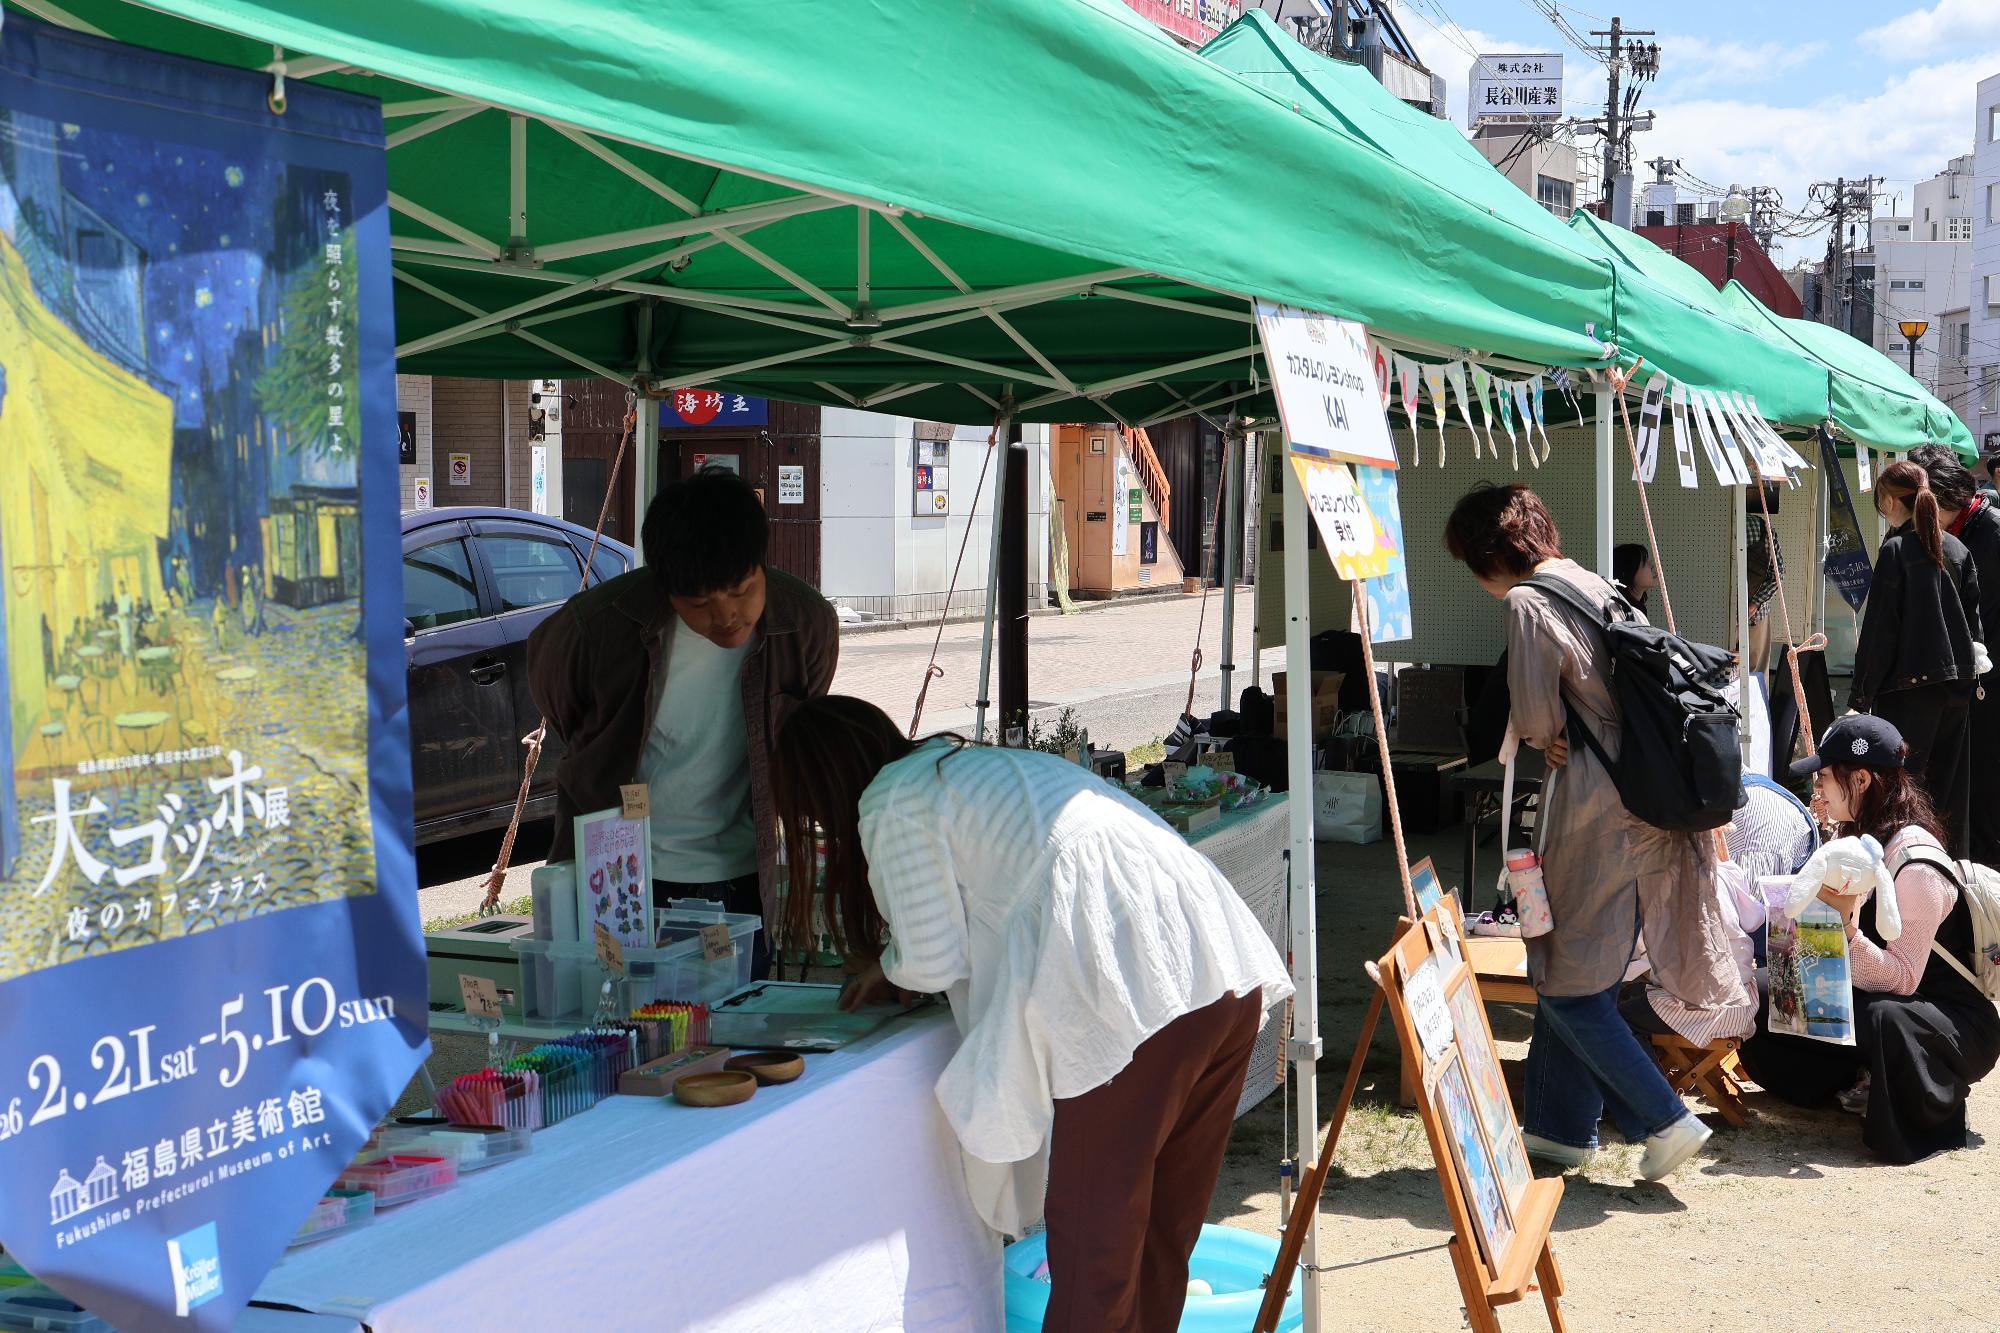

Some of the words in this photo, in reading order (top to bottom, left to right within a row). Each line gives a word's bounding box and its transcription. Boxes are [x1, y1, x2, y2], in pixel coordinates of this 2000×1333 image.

[1498, 63, 1544, 73] 株式会社
[1485, 86, 1557, 105] 長谷川産業
[678, 393, 750, 413] 海坊主
[1323, 394, 1350, 431] KAI
[1334, 520, 1355, 541] 受付
[31, 750, 291, 898] 大ゴッホ展
[66, 873, 267, 941] 夜のカフェテラス
[122, 1086, 325, 1192] 福島県立美術館
[56, 1207, 131, 1249] Fukushima
[136, 1171, 214, 1215] Prefectural
[218, 1150, 273, 1180] Museum
[278, 1141, 295, 1159] of
[302, 1133, 332, 1152] Art
